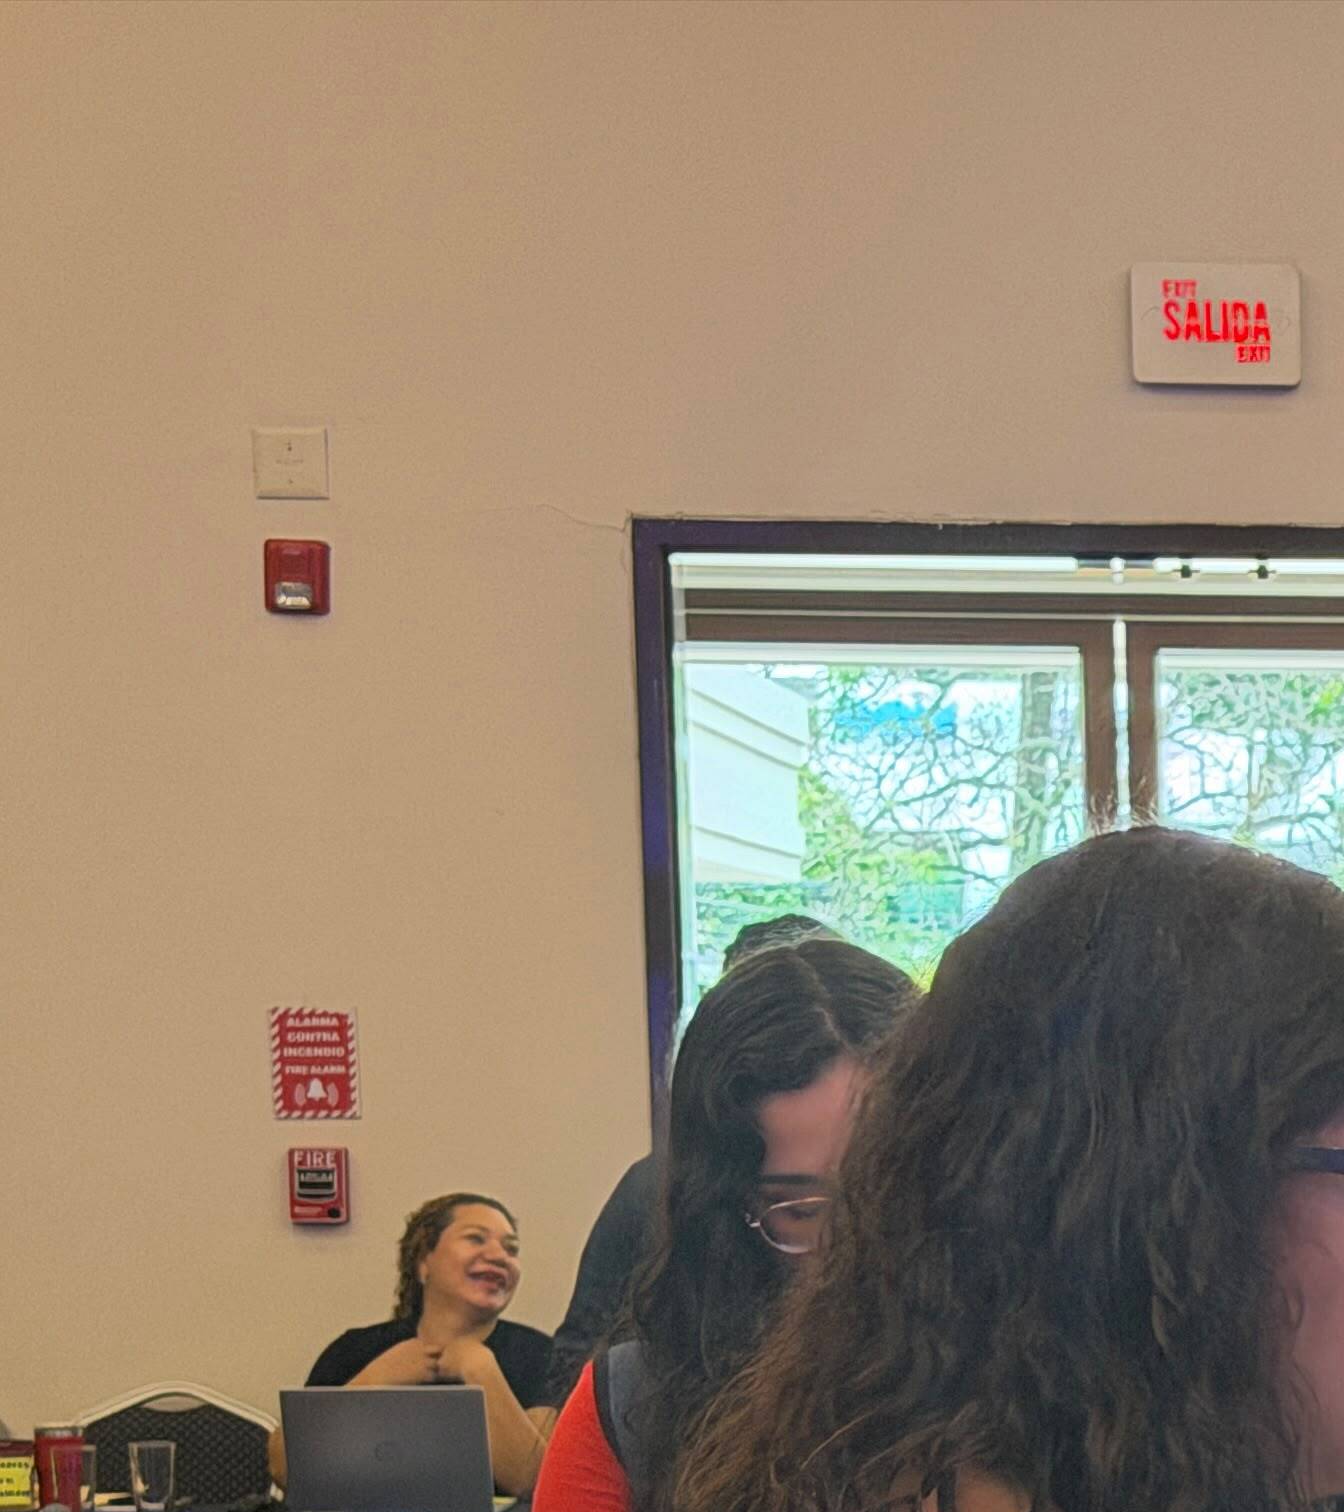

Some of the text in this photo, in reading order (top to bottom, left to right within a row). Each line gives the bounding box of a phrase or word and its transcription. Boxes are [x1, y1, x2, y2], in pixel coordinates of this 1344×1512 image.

[1162, 299, 1271, 343] SALIDA
[1236, 345, 1271, 364] EXIT
[286, 1031, 341, 1042] CONTRA
[282, 1046, 345, 1058] INCENDIO
[293, 1150, 337, 1168] FIRE
